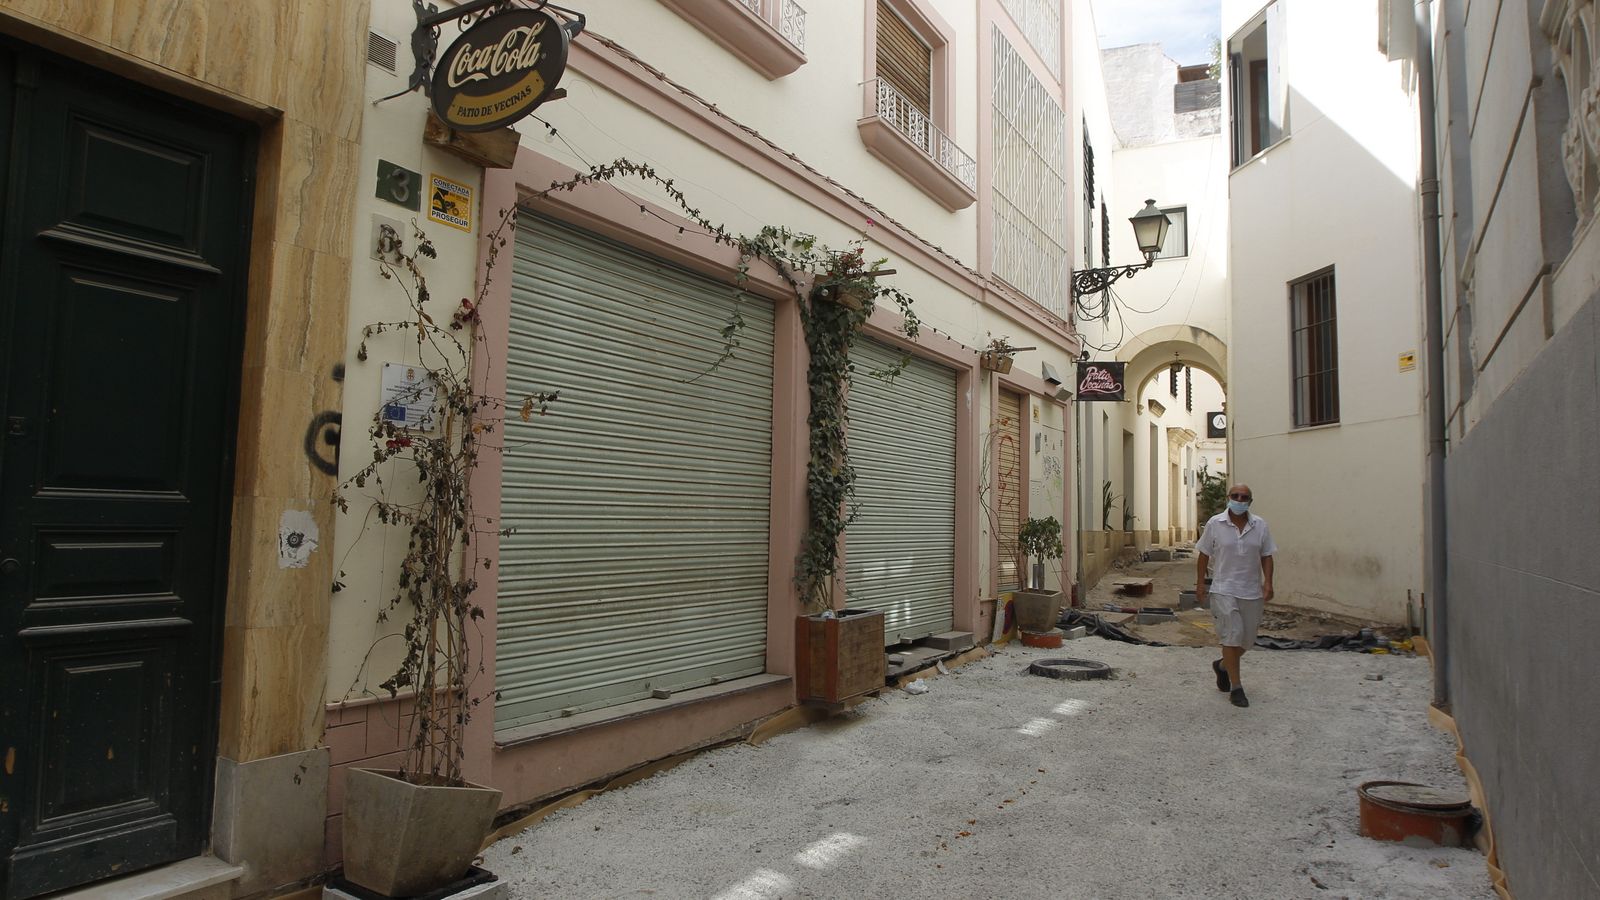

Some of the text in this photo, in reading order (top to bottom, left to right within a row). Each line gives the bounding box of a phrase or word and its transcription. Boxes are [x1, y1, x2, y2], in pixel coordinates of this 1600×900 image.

[457, 85, 532, 118] PATIO DE VECINAS
[390, 168, 410, 202] 3
[433, 178, 470, 196] CONECTADA
[431, 210, 469, 227] PROSEGUR
[1086, 366, 1111, 380] Patio
